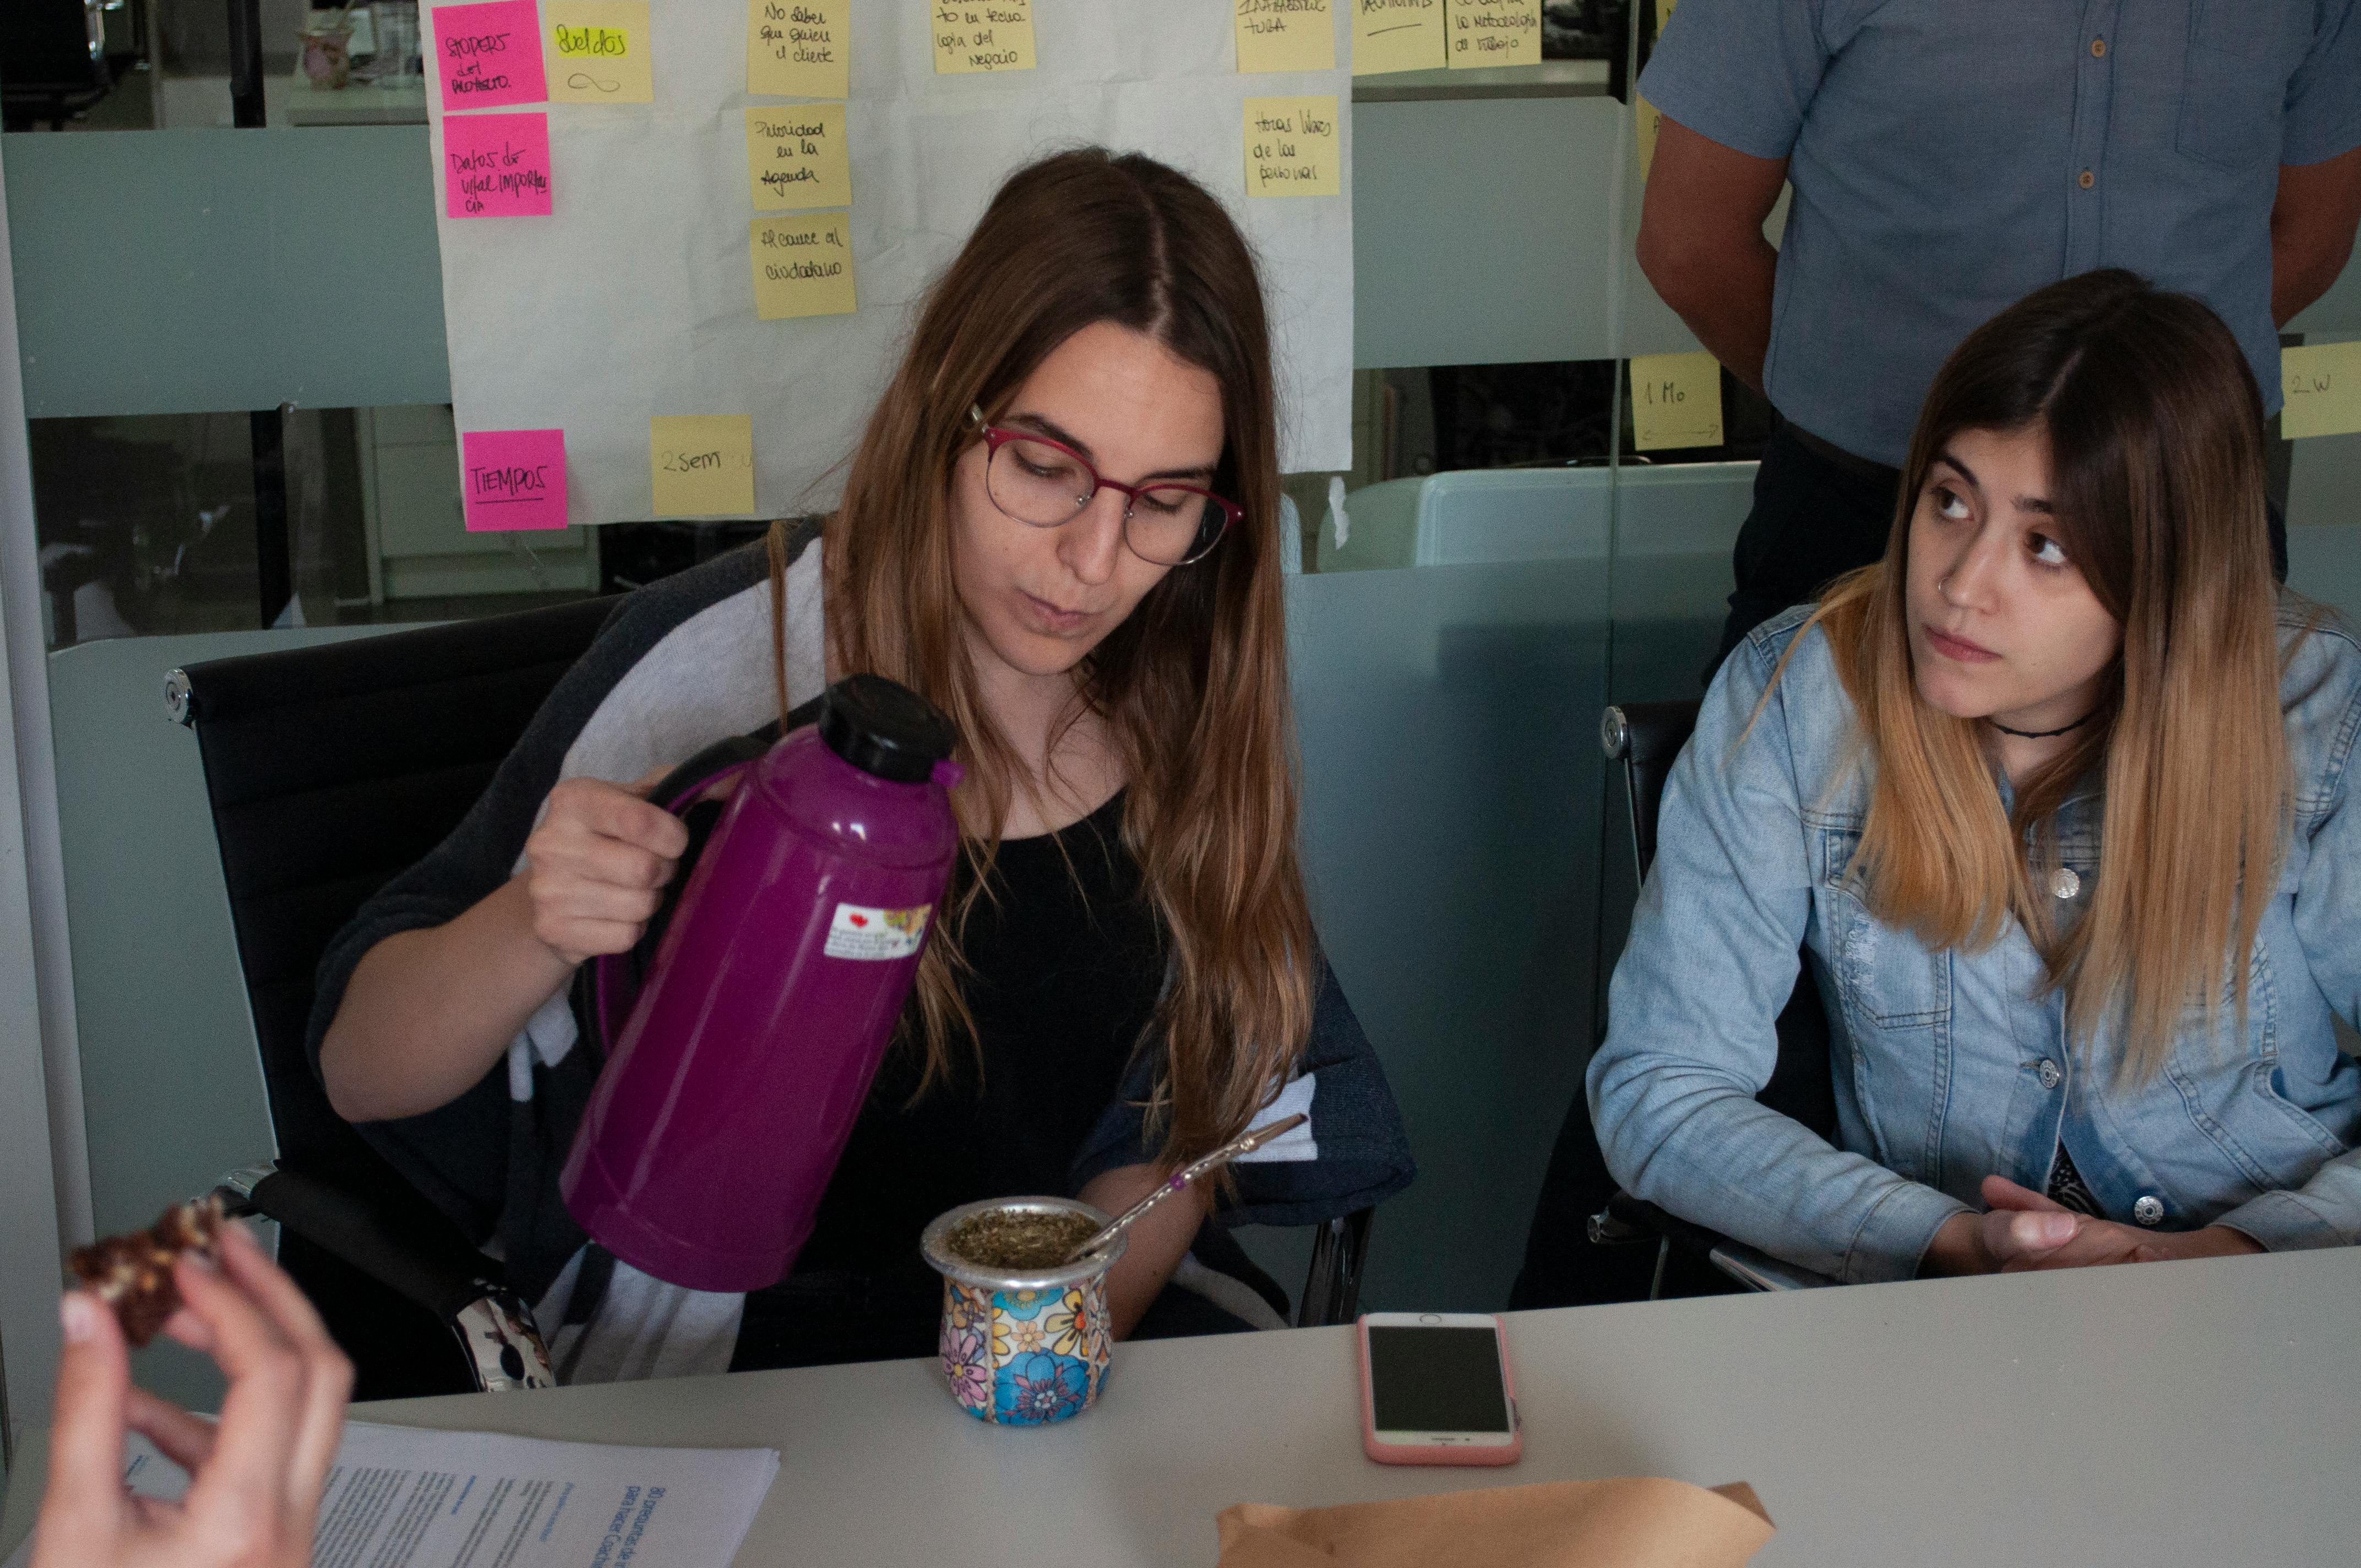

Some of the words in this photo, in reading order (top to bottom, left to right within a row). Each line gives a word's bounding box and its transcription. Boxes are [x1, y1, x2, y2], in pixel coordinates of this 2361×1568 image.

[765, 2, 785, 19] No
[973, 29, 993, 46] del
[1253, 144, 1271, 160] de
[2292, 375, 2310, 393] 2
[470, 466, 548, 496] TIEMPOS
